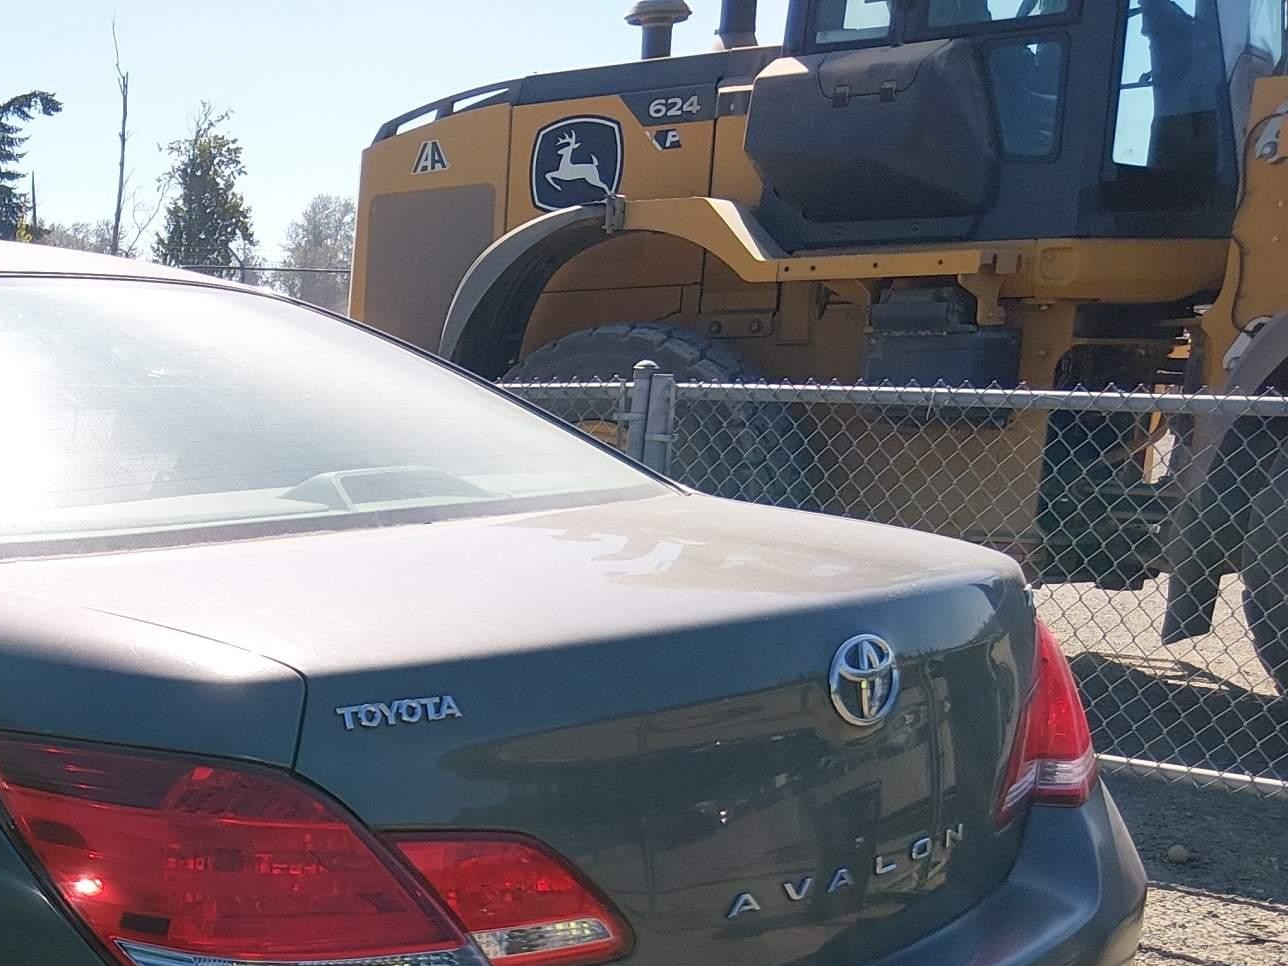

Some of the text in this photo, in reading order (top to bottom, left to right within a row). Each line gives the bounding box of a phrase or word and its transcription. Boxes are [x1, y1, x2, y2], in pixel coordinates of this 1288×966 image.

[648, 95, 701, 119] 624
[335, 695, 464, 730] TOYOTA
[726, 823, 964, 919] AVALON
